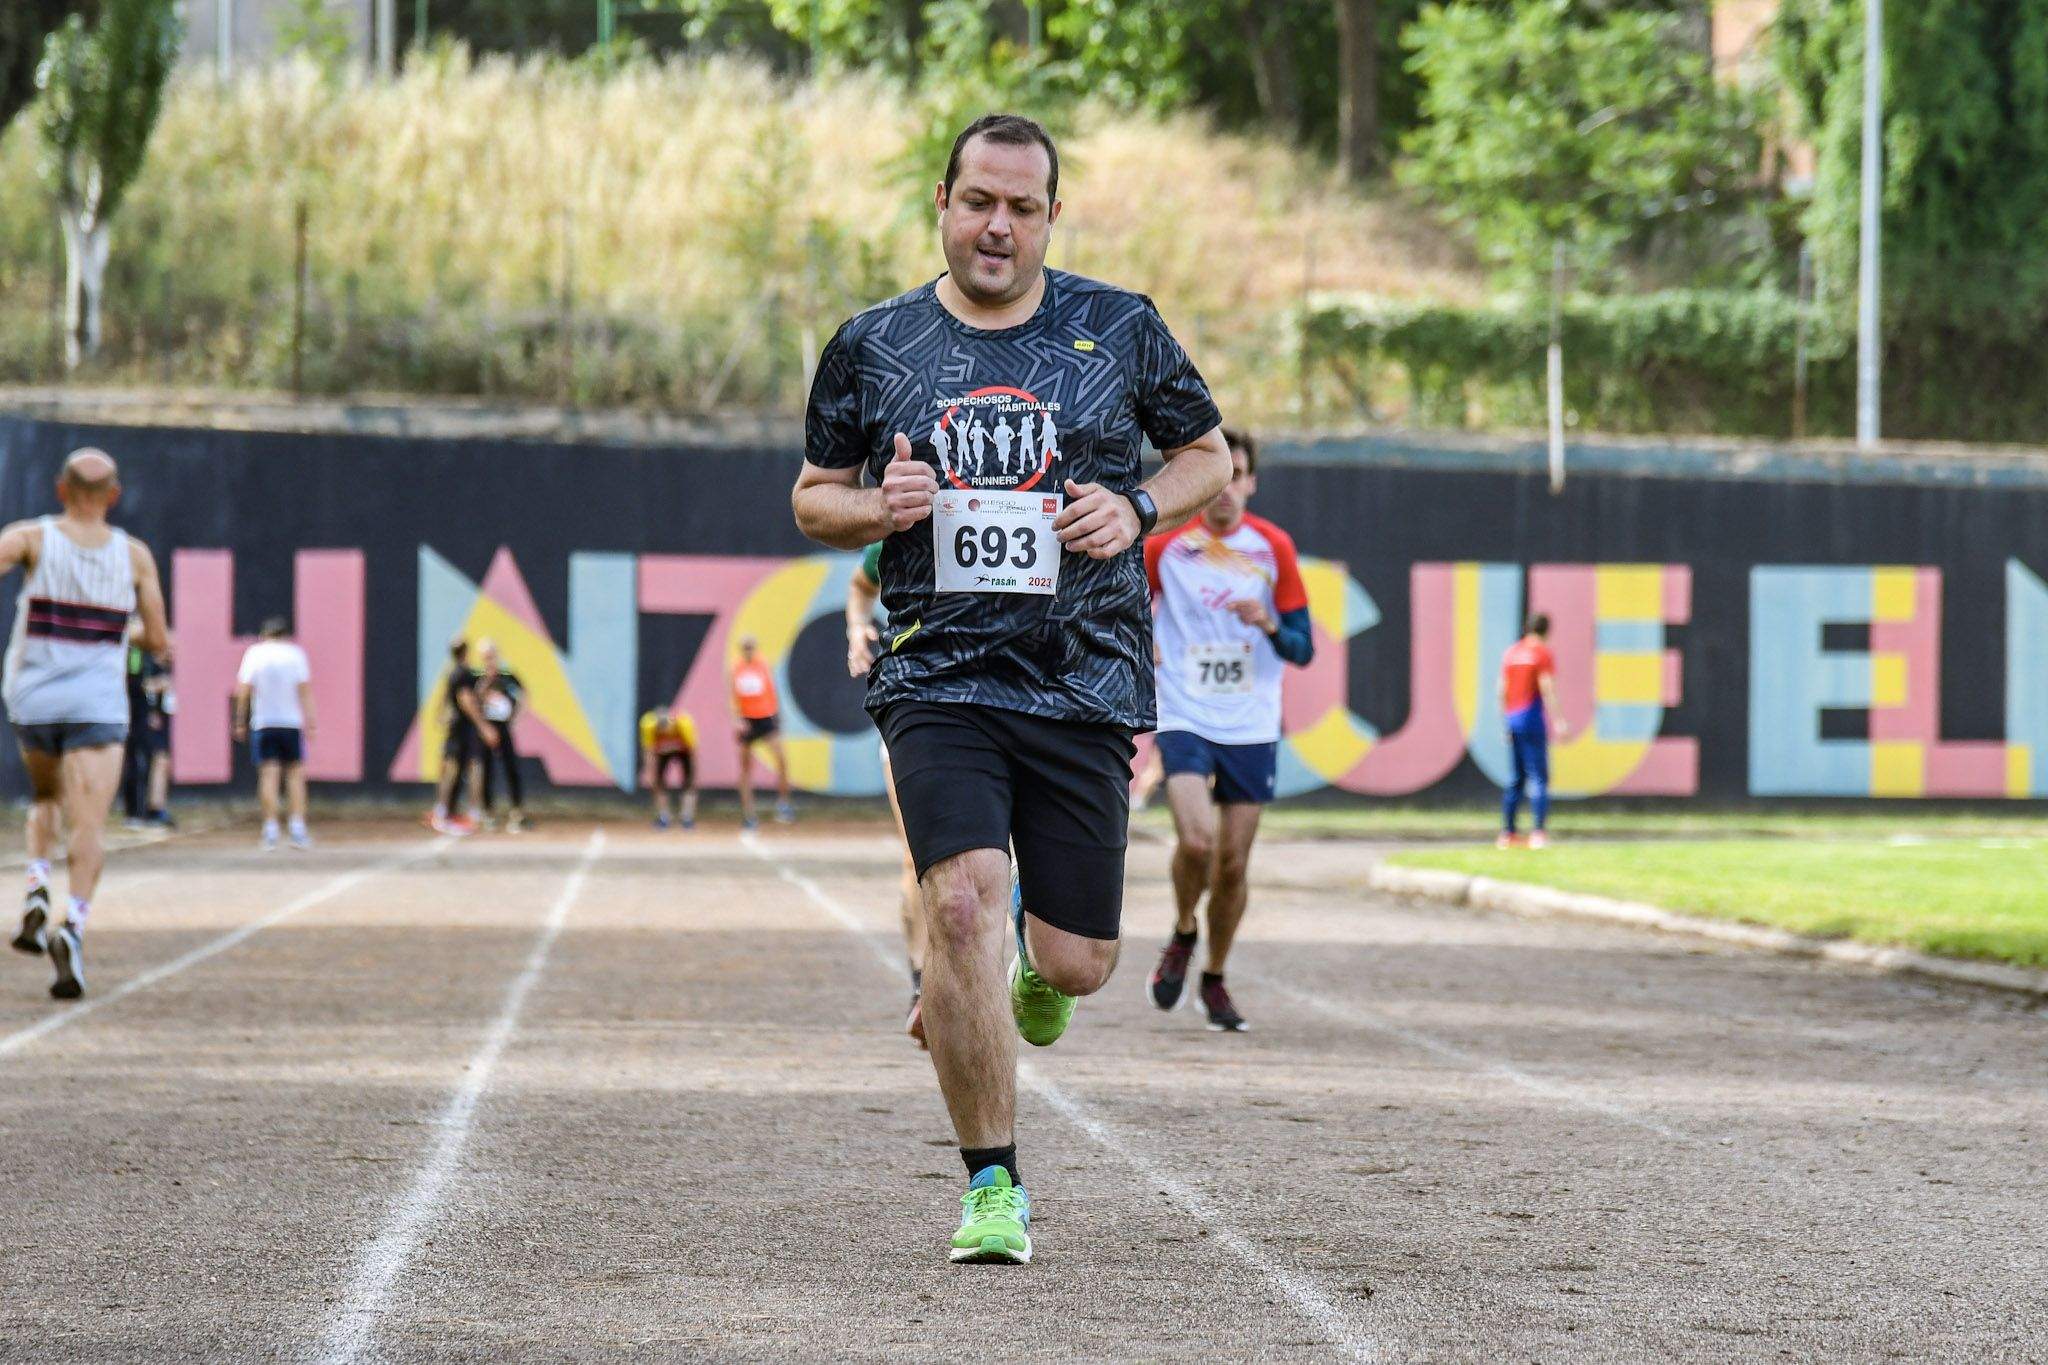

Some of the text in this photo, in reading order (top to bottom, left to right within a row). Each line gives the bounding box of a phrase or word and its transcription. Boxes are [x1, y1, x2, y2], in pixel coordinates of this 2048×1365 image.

[937, 395, 1012, 408] SOSPECHOSOS
[997, 402, 1060, 412] HABITUALES
[971, 476, 1018, 486] RUNNERS
[954, 525, 1037, 569] 693
[991, 576, 1052, 588] rasán 2023
[1199, 660, 1243, 684] 705
